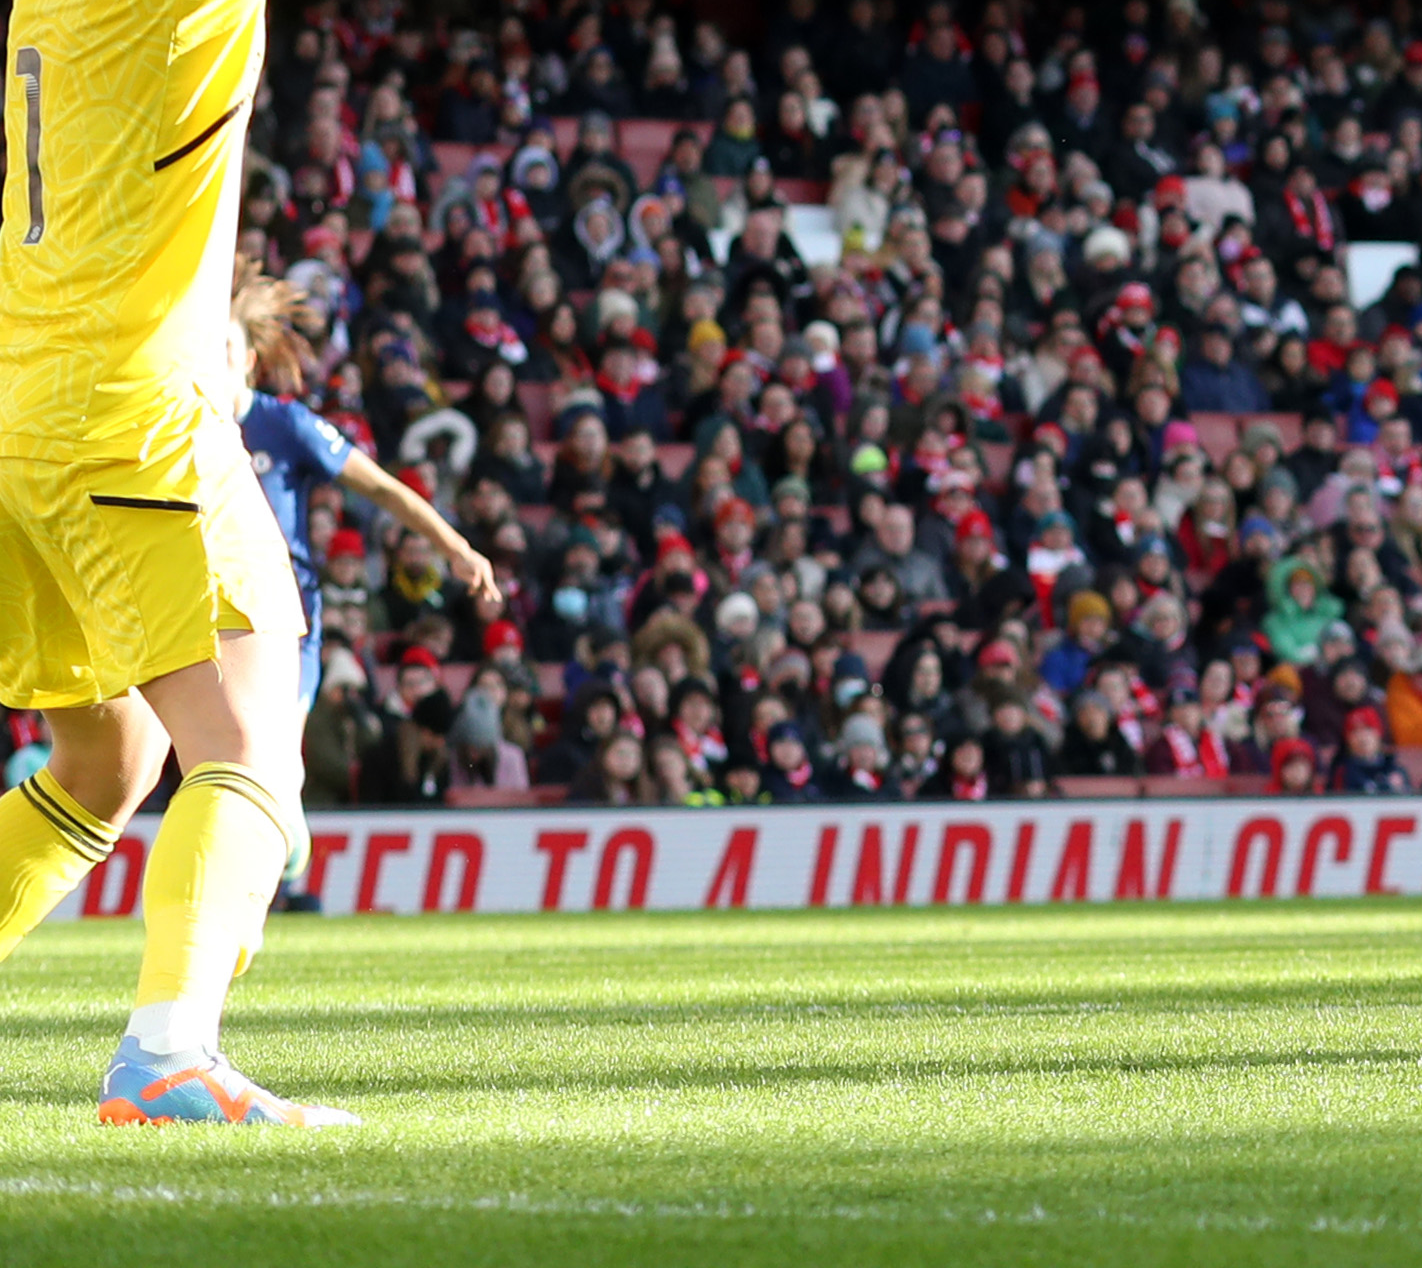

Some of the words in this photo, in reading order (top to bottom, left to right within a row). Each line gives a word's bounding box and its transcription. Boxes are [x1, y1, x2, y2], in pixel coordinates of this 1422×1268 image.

[16, 48, 44, 245] 1
[533, 826, 655, 911] TO
[705, 827, 759, 908] A
[808, 818, 1185, 905] INDIAN
